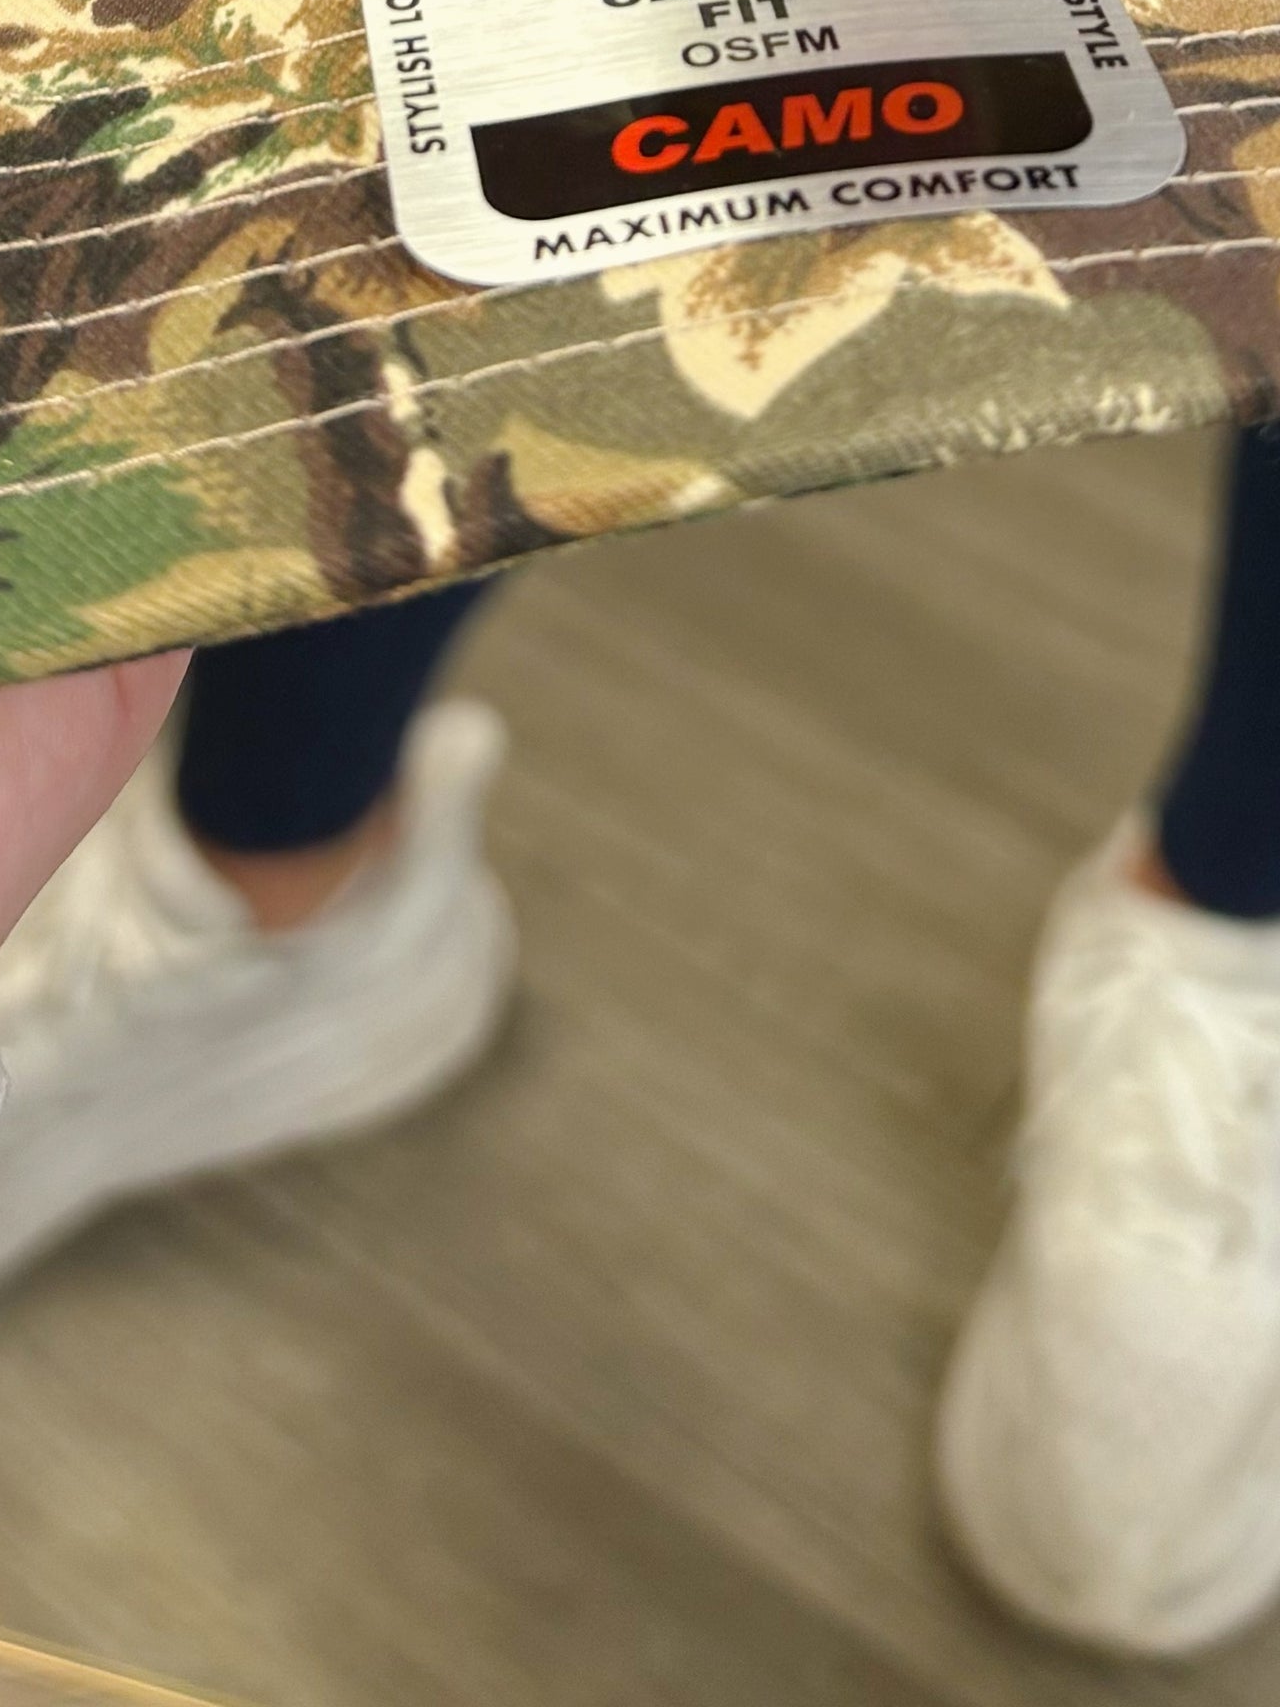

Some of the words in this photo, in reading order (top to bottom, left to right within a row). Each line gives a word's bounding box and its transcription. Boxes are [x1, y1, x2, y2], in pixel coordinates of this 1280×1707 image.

[681, 25, 840, 67] OSFM
[392, 34, 447, 154] STYLISH
[610, 81, 965, 174] CAMO
[534, 189, 810, 261] MAXIMUM
[831, 164, 1081, 206] COMFORT
